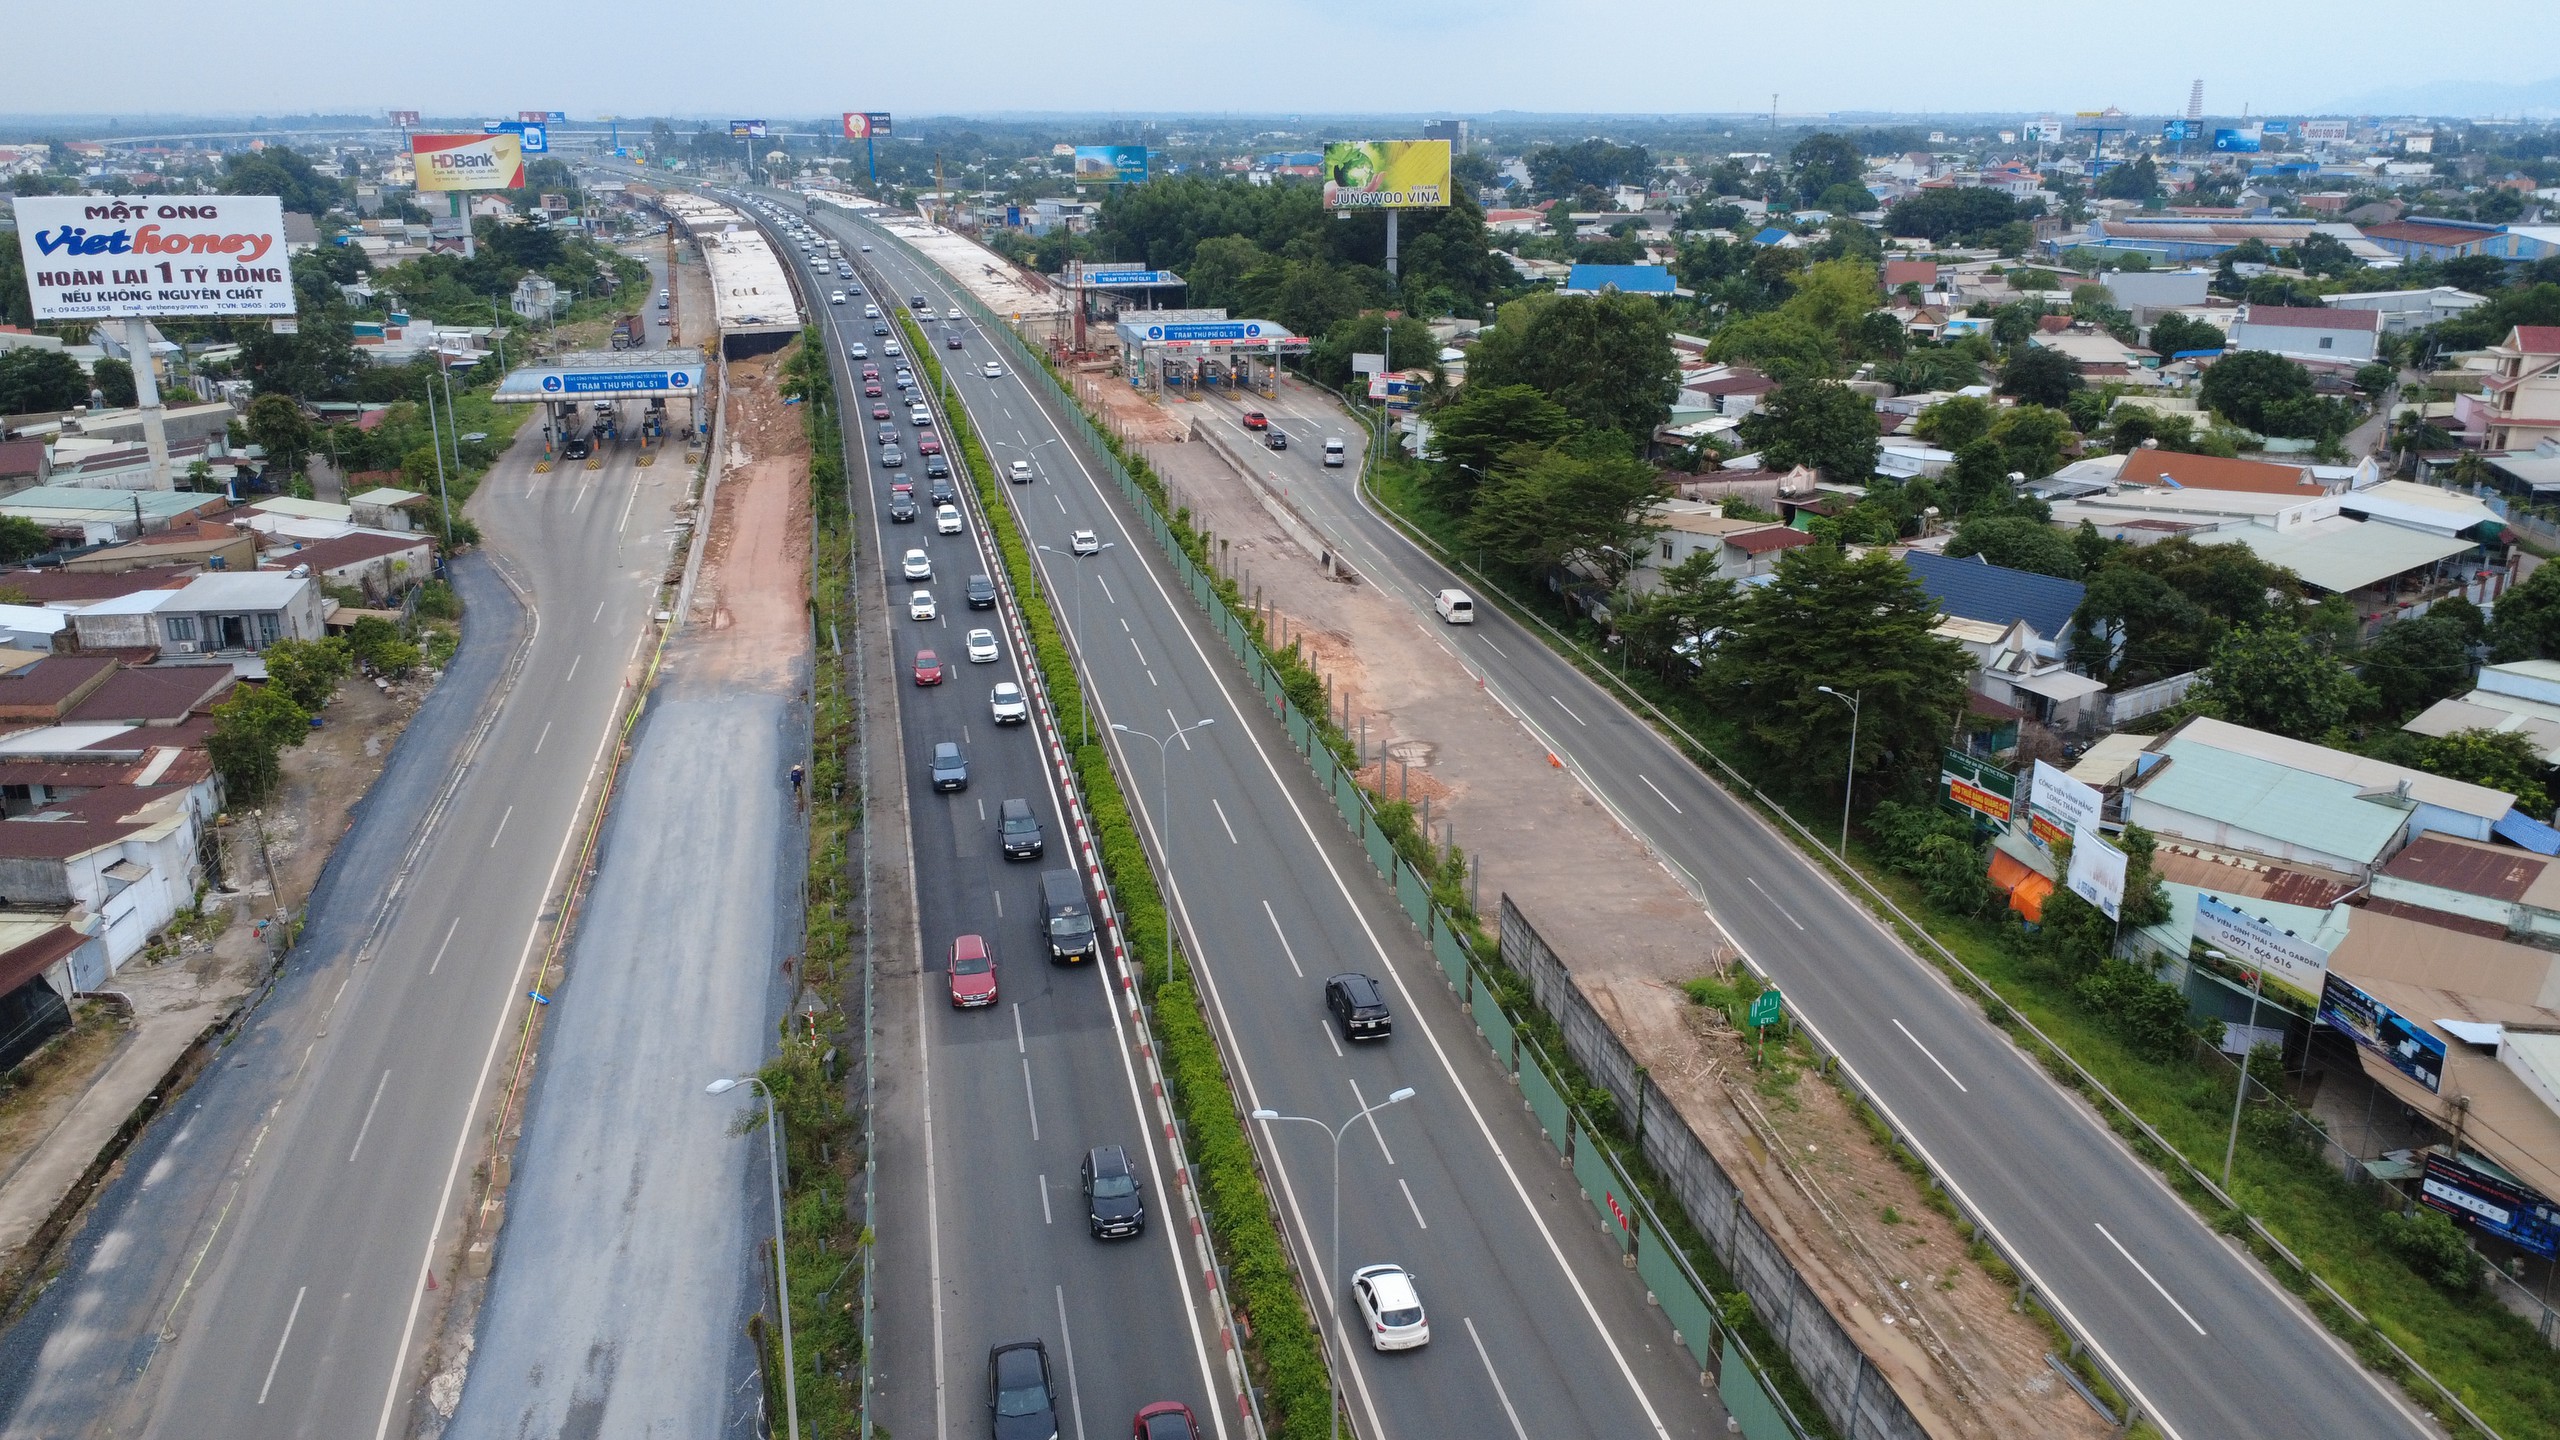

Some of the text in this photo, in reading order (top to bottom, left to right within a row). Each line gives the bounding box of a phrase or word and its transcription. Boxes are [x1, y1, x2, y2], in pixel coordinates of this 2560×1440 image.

[430, 152, 494, 168] HDBank
[1332, 192, 1440, 204] JUNGWOO VINA
[84, 200, 218, 223] MẬT ONG
[35, 224, 272, 262] Viethoney
[37, 262, 282, 288] HOÀN LẠI 1 TỶ ĐỒNG
[61, 288, 92, 303] NẾU
[97, 288, 152, 302] KHÔNG
[158, 288, 220, 301] NGUYÊN
[577, 382, 600, 391] TRẠM
[622, 380, 634, 388] PHÍ
[1984, 766, 2009, 780] JUNCTION
[2038, 778, 2054, 791] CÔNG
[2054, 786, 2066, 797] VIÊN
[2046, 792, 2062, 806] LONG
[2062, 800, 2082, 817] THÀNH
[2200, 908, 2214, 920] HOA
[2216, 916, 2232, 928] VIÊN
[2233, 925, 2250, 937] SINH
[2269, 942, 2287, 955] SALA
[2288, 952, 2320, 969] GARDEN
[2230, 934, 2251, 950] 0971
[2254, 946, 2272, 960] 666
[2274, 956, 2292, 968] 616
